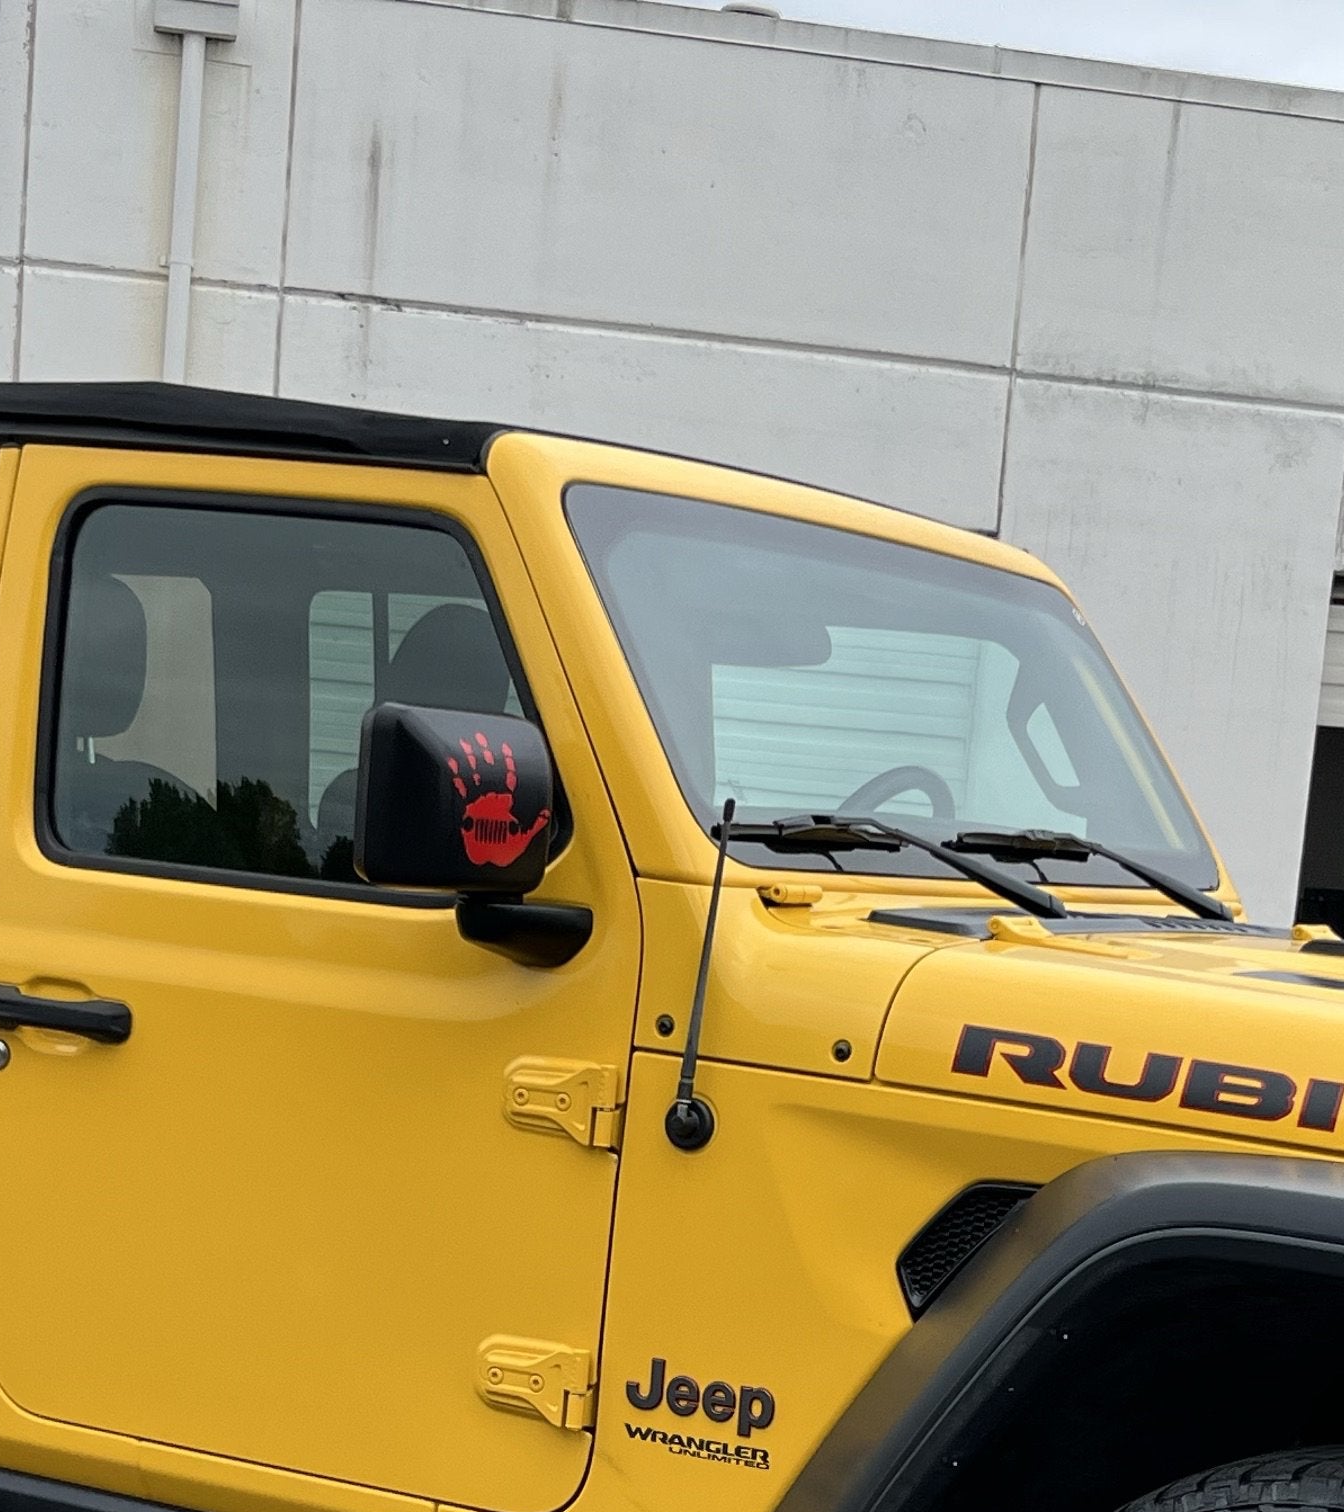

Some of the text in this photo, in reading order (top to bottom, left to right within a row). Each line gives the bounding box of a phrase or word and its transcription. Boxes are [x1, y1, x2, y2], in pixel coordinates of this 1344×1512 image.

[626, 1357, 775, 1438] Jeep
[624, 1422, 771, 1464] WRANGLER
[668, 1445, 771, 1470] UNLIMITED
